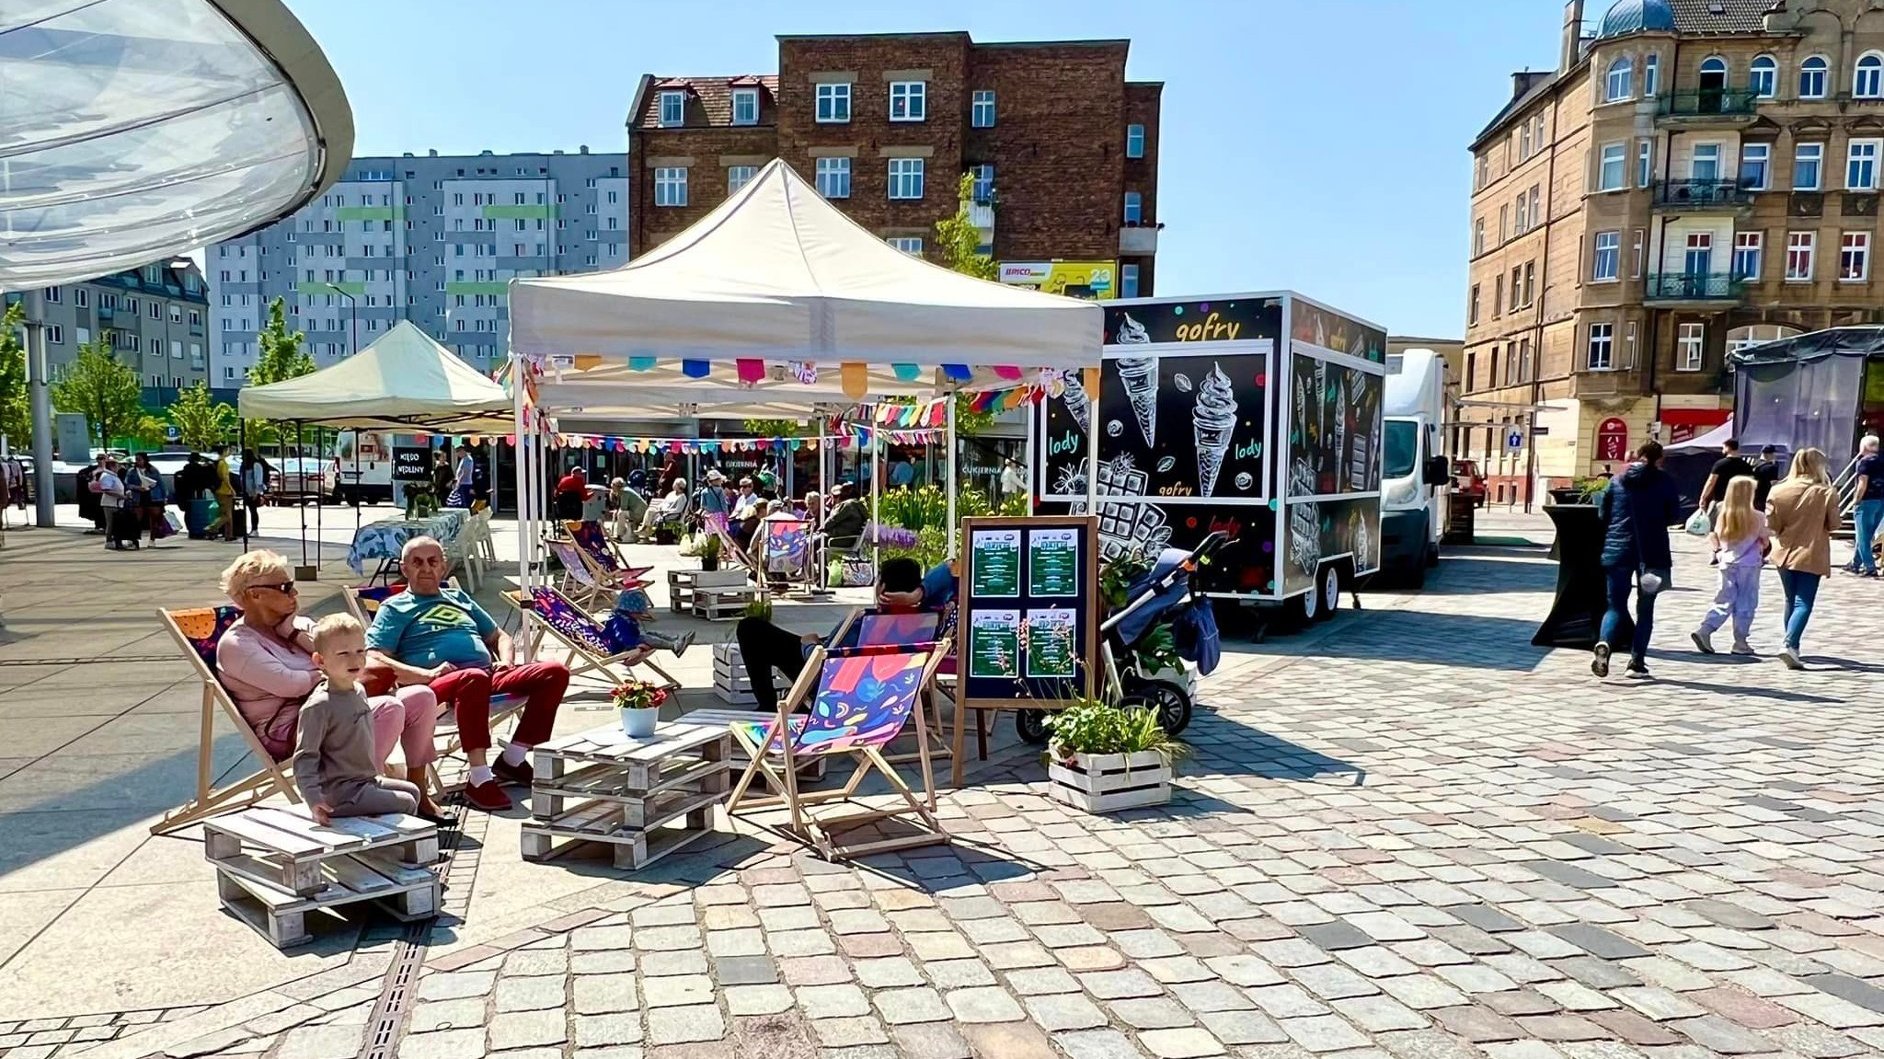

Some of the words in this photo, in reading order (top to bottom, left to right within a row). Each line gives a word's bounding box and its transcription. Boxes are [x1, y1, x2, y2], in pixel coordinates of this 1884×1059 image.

[1176, 312, 1240, 342] gofry
[1048, 430, 1079, 456] lody
[1235, 438, 1262, 460] lody
[1158, 481, 1193, 497] gofry
